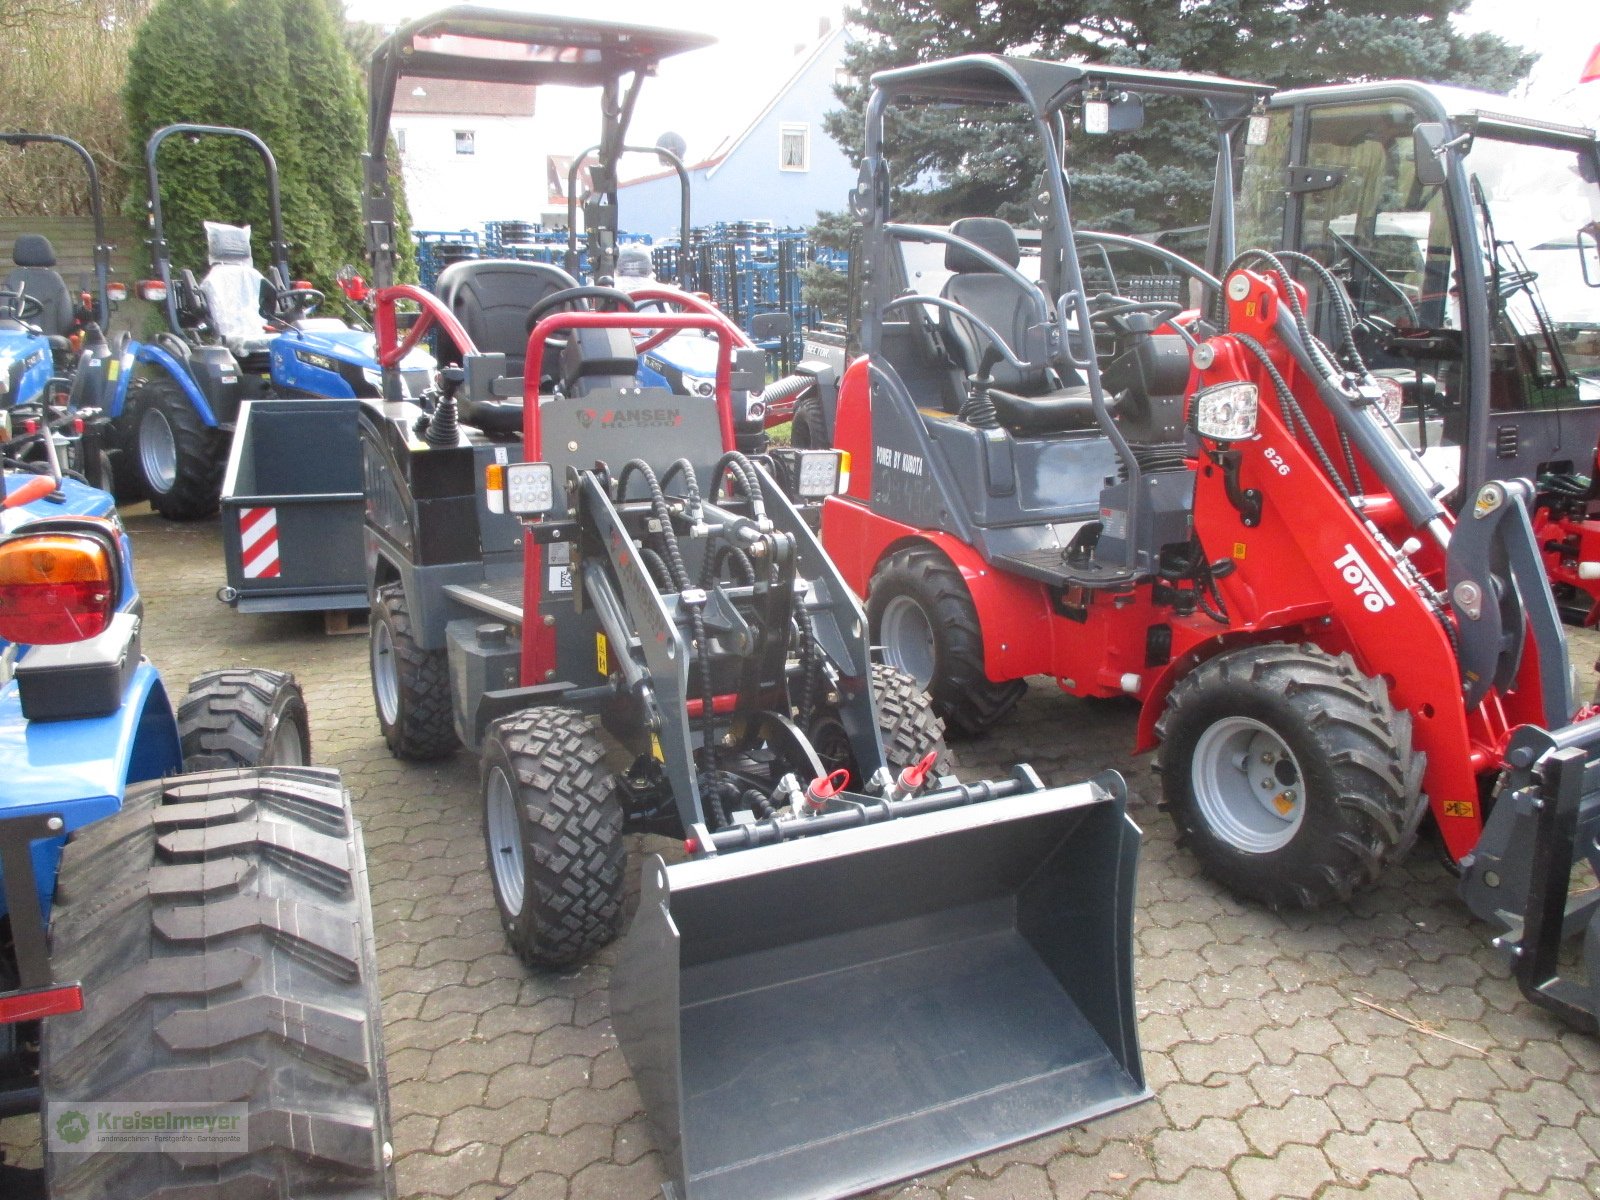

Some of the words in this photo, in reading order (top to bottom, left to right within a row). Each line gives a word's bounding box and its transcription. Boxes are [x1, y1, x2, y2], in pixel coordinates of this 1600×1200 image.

[600, 409, 680, 422] JANSEN
[876, 445, 893, 468] POWER
[893, 450, 902, 470] BY
[902, 453, 923, 477] KUBOTA
[1263, 447, 1291, 476] 826
